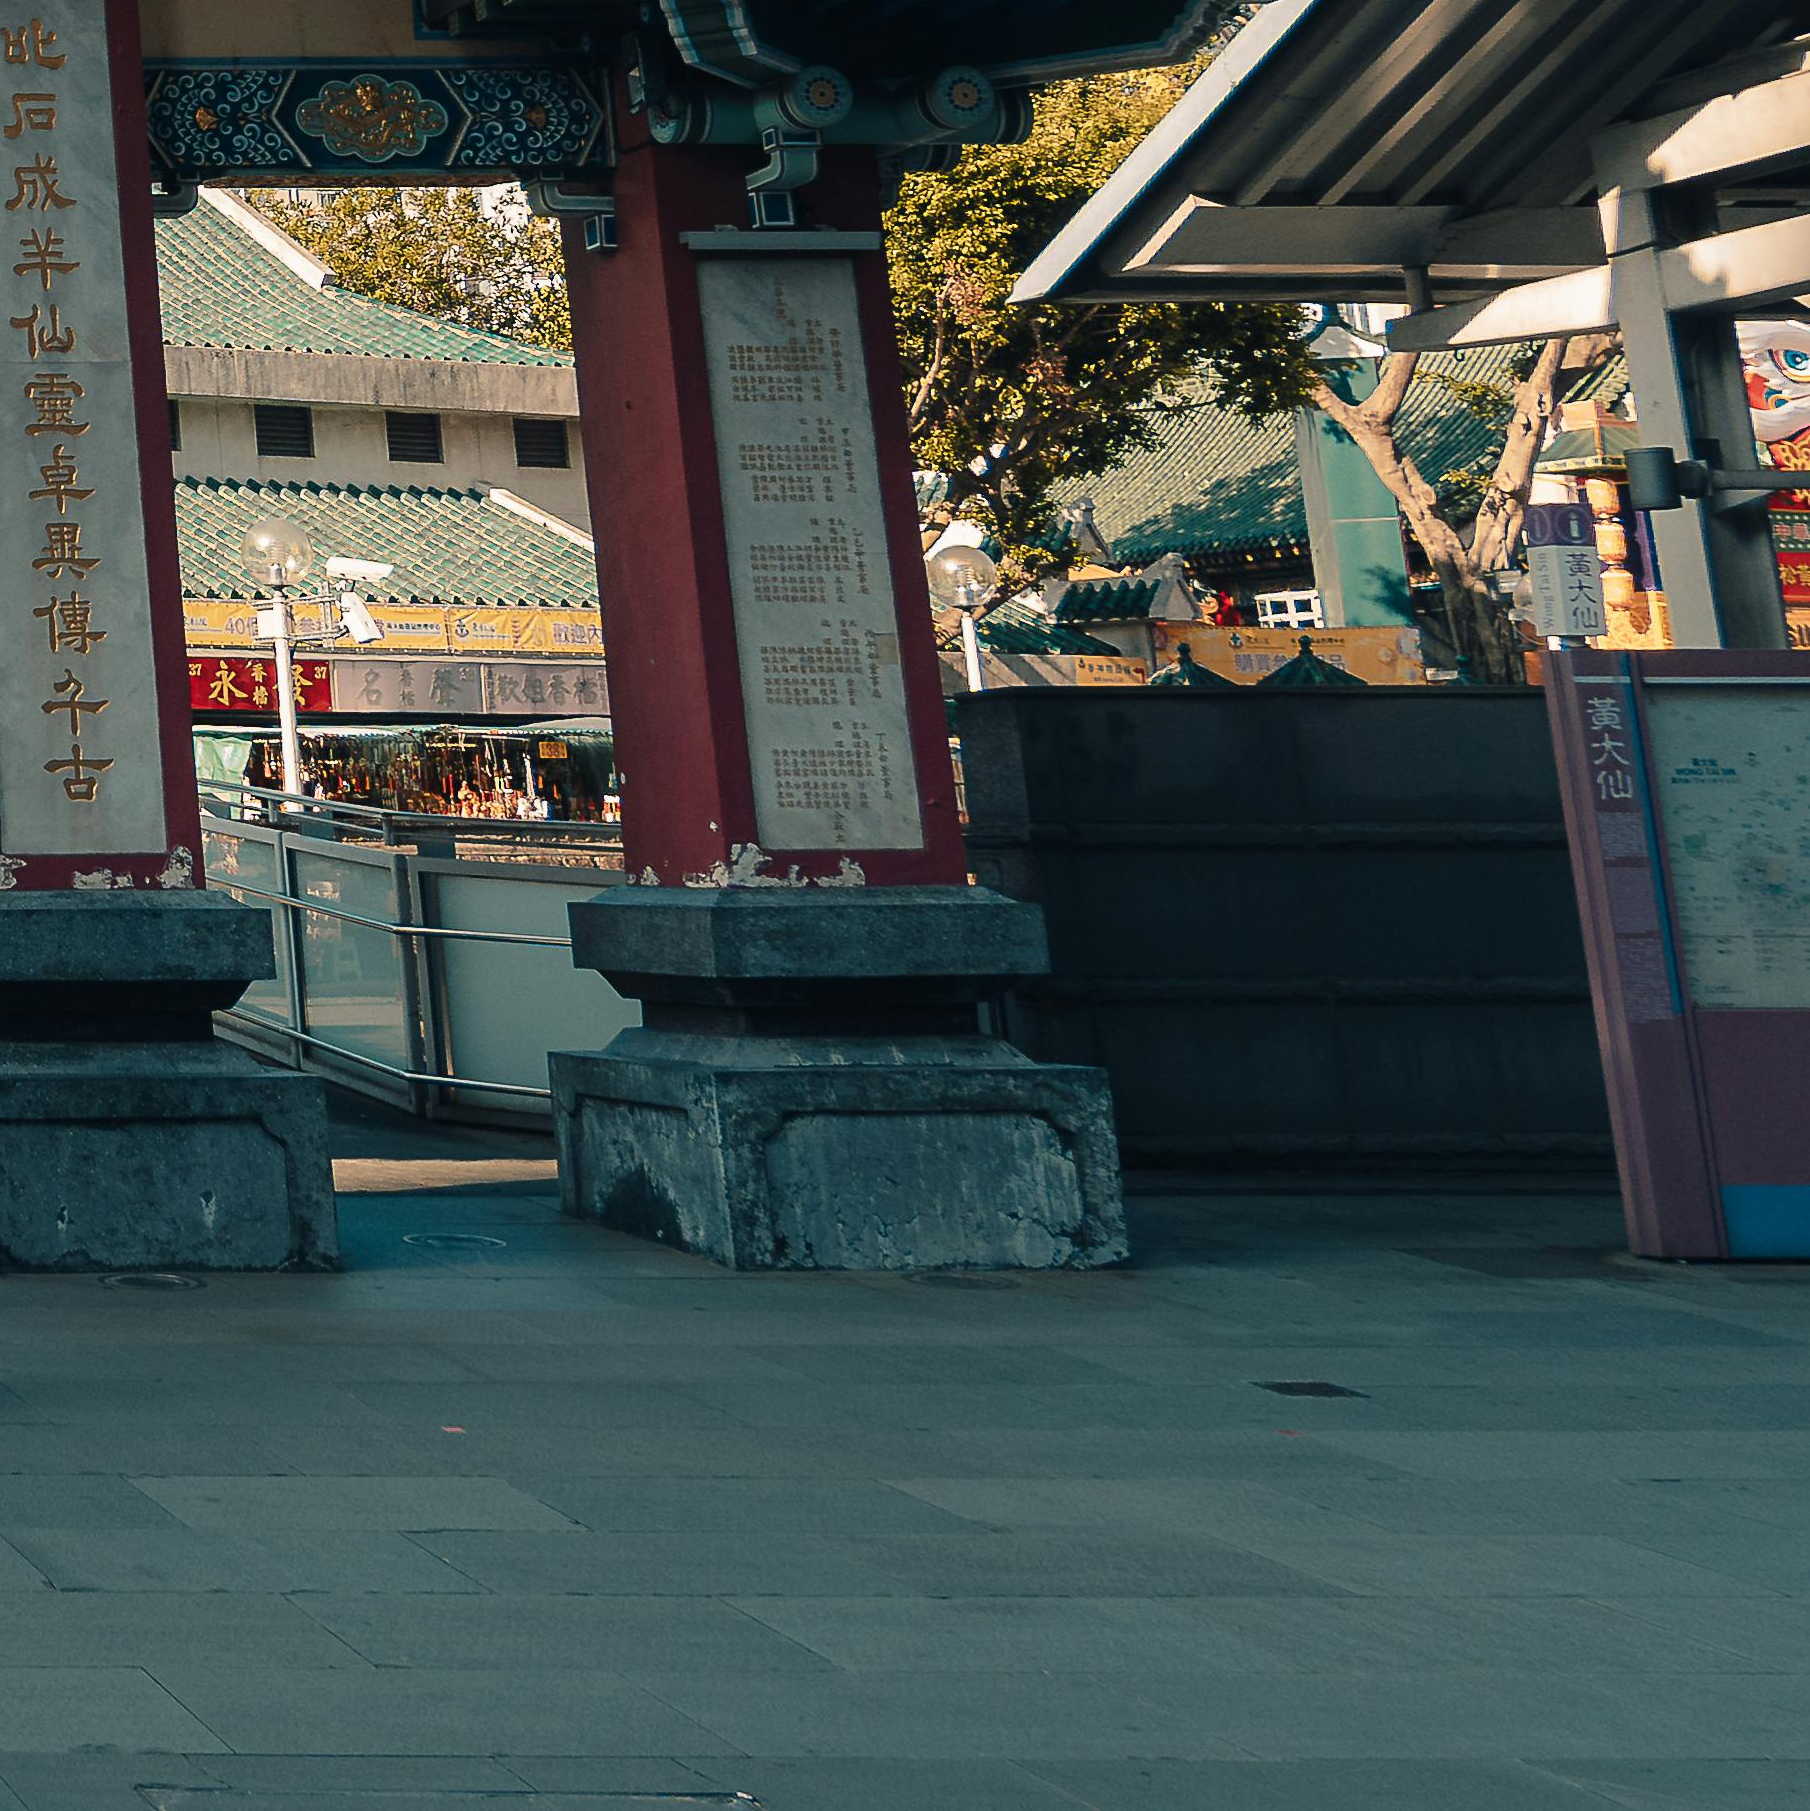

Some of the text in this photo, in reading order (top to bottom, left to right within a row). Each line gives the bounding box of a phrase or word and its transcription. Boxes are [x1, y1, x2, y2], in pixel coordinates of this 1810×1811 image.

[1564, 552, 1599, 629] 黃大仙
[188, 662, 203, 677] 37
[314, 665, 327, 680] 37
[1585, 696, 1634, 800] 黃大仙
